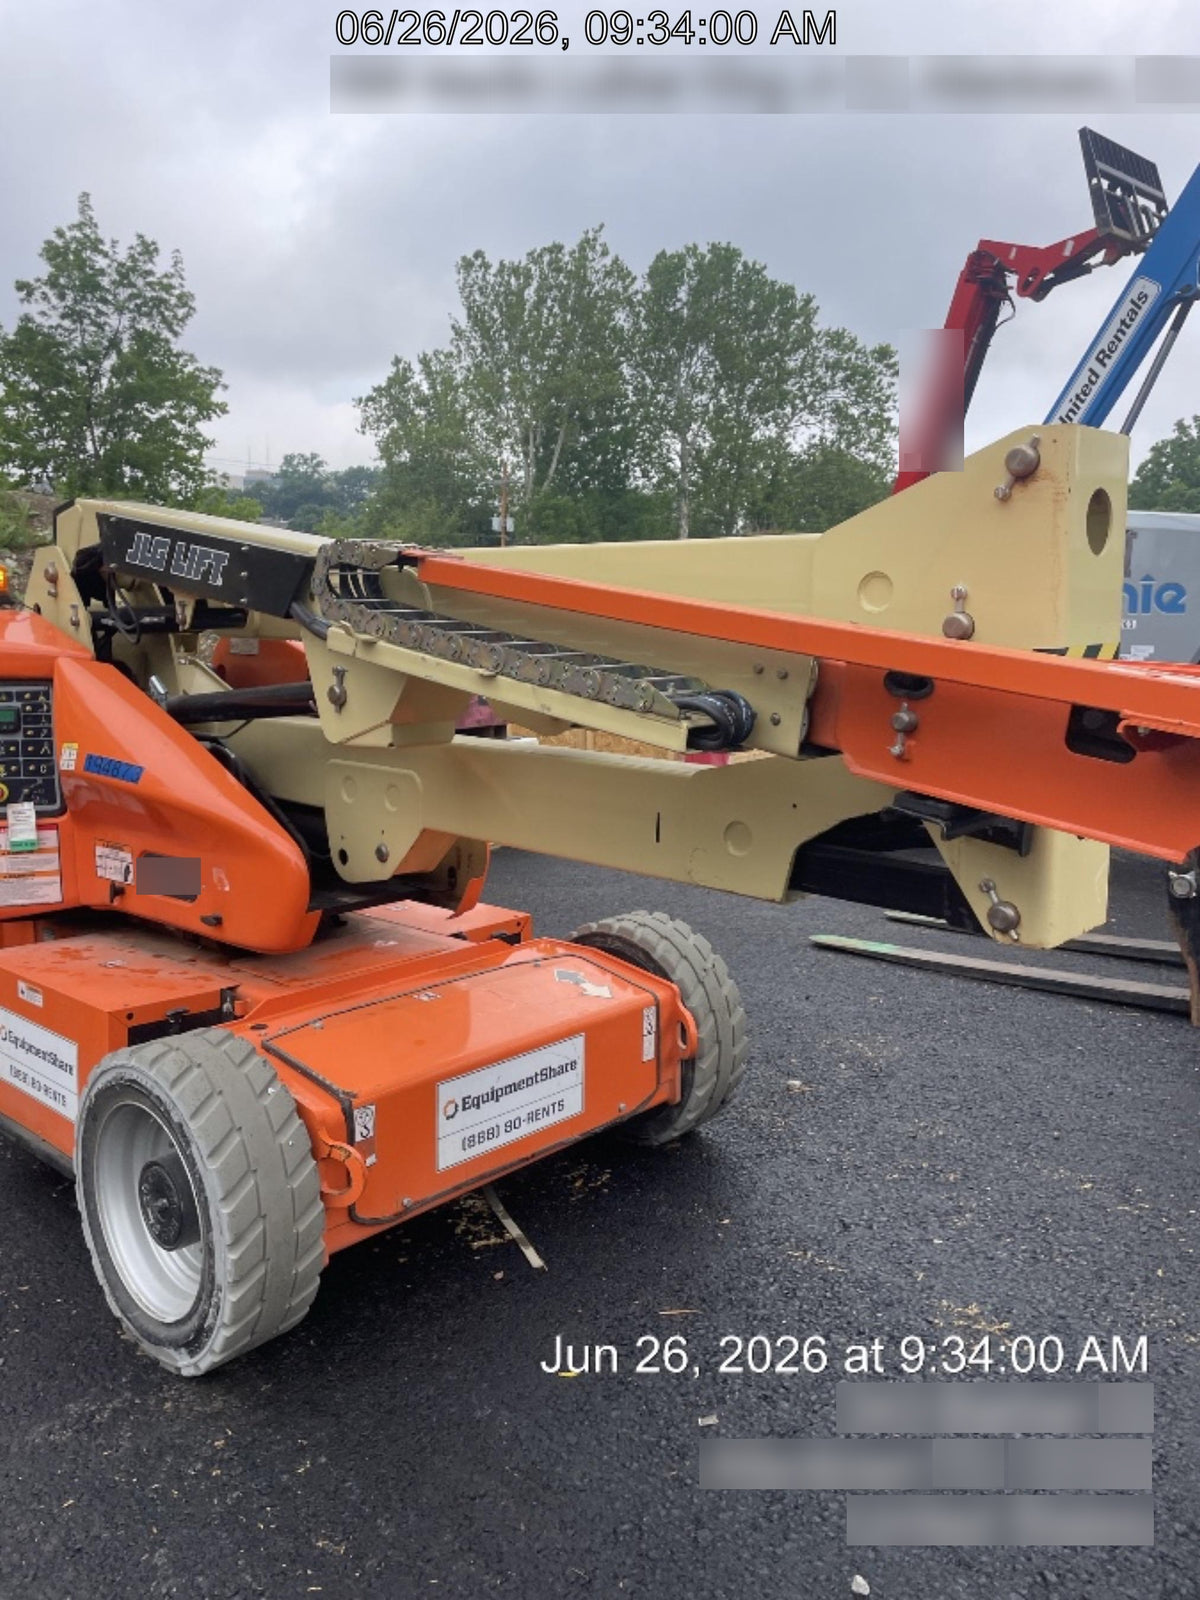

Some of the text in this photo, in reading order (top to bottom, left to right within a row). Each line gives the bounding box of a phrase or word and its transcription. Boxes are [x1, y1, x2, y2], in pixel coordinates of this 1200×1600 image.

[1094, 290, 1149, 369] Rentals
[126, 531, 230, 587] JLG LIFT
[1123, 573, 1187, 614] nie
[461, 1059, 578, 1112] EquipmentShare
[461, 1098, 565, 1152] (888) 80-RENTS
